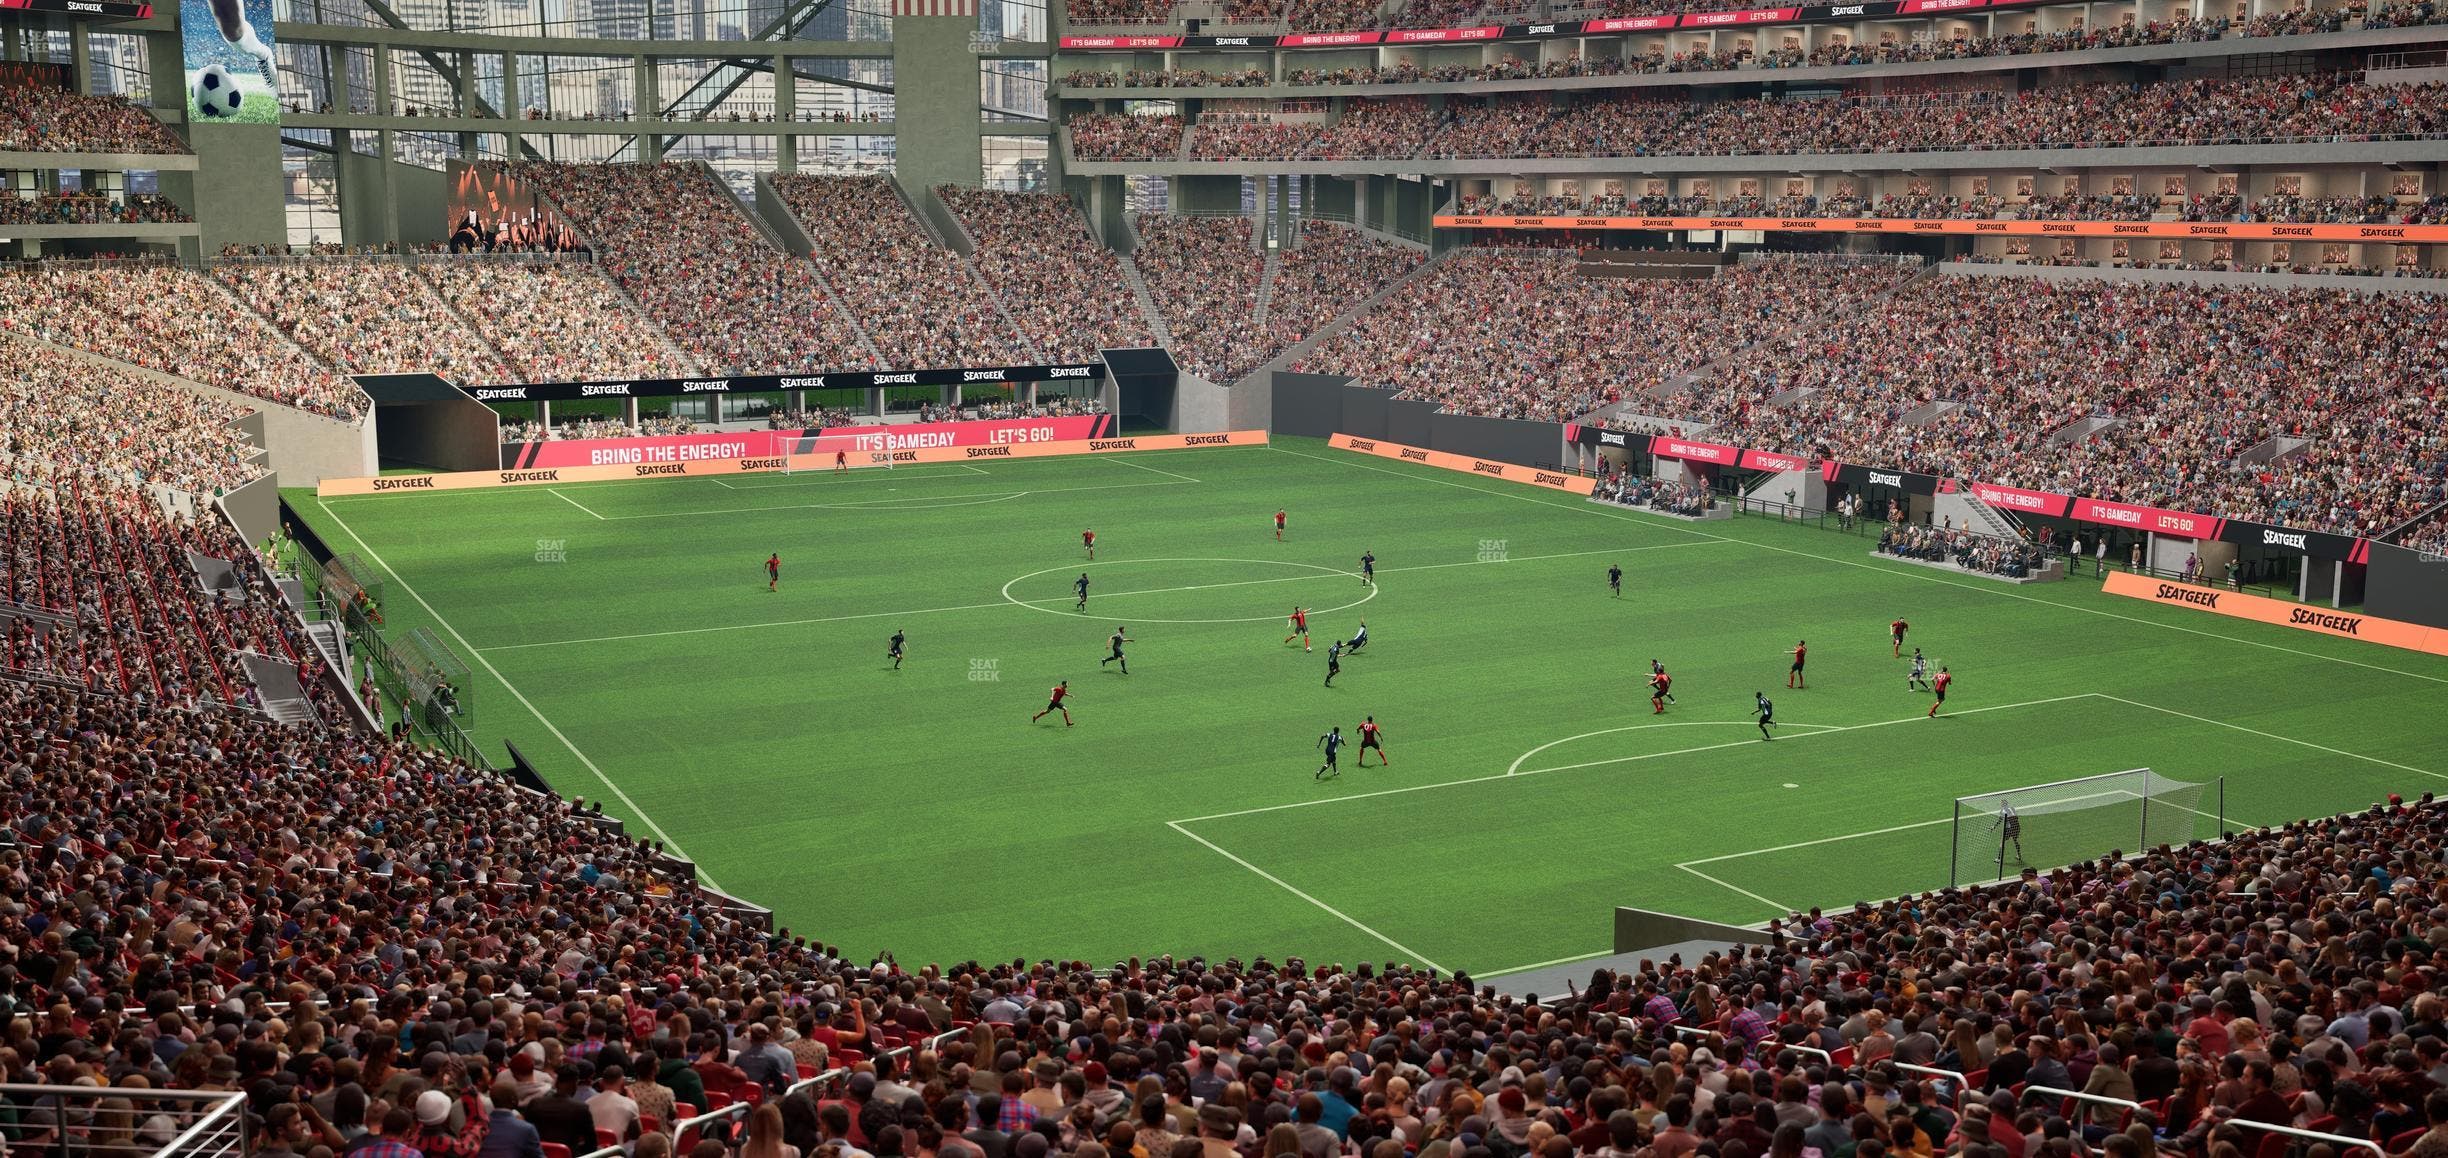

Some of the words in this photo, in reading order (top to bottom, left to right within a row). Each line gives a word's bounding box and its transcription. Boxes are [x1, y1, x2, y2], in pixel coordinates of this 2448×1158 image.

[68, 1, 103, 13] SEATGEEK
[1831, 4, 1864, 16] SEATGEEK
[1605, 20, 1623, 30] BRING
[1623, 20, 1634, 29] THE
[1634, 18, 1658, 28] ENERGY!
[1697, 15, 1709, 24] IT'S
[1709, 14, 1737, 23] GAMEDAY
[1750, 12, 1767, 21] LET'S
[1767, 12, 1779, 20] GO!
[1403, 32, 1415, 40] IT'S
[1416, 31, 1447, 40] GAMEDAY
[1460, 30, 1476, 39] LET'S
[1528, 24, 1555, 35] SEATGEEK
[1129, 39, 1147, 47] LET'S
[1148, 39, 1160, 47] GO!
[1215, 37, 1249, 47] SEATGEEK
[1302, 36, 1322, 45] BRING
[1322, 35, 1333, 44] THE
[1334, 34, 1361, 44] ENERGY!
[1455, 218, 1483, 226] SEATGEEK
[1514, 218, 1544, 226] SEATGEEK
[1576, 218, 1607, 227] SEATGEEK
[1641, 218, 1674, 228] SEATGEEK
[1710, 220, 1744, 228] SEATGEEK
[1782, 220, 1817, 229] SEATGEEK
[1855, 221, 1883, 230] SEATGEEK
[1913, 222, 1943, 231] SEATGEEK
[1976, 222, 2008, 232] SEATGEEK
[2042, 223, 2076, 233] SEATGEEK
[2113, 224, 2149, 234] SEATGEEK
[2190, 225, 2228, 236] SEATGEEK
[2272, 226, 2313, 237] SEATGEEK
[2360, 227, 2405, 239] SEATGEEK
[963, 370, 1006, 382] SEATGEEK
[1050, 366, 1091, 379] SEATGEEK
[779, 376, 826, 389] SEATGEEK
[873, 373, 918, 386] SEATGEEK
[581, 384, 631, 397] SEATGEEK
[682, 380, 731, 393] SEATGEEK
[476, 388, 527, 401] SEATGEEK
[856, 435, 884, 451] IT'S
[887, 431, 956, 450] GAMEDAY
[989, 428, 1028, 445] LET'S
[1030, 427, 1055, 442] GO!
[1185, 434, 1230, 447] SEATGEEK
[1600, 432, 1626, 446] SEATGEEK
[1089, 439, 1136, 451] SEATGEEK
[1349, 438, 1376, 453] SEATGEEK
[1670, 443, 1687, 454] BRING
[1688, 445, 1697, 456] THE
[1698, 446, 1720, 459] ENERGY!
[590, 447, 642, 465] BRING
[646, 446, 676, 462] THE
[679, 442, 746, 461] ENERGY!
[966, 446, 1012, 459] SEATGEEK
[1400, 448, 1429, 462] SEATGEEK
[740, 458, 788, 471] SEATGEEK
[1472, 460, 1505, 476] SEATGEEK
[1756, 456, 1768, 467] IT'S
[635, 463, 687, 476] SEATGEEK
[373, 476, 434, 491] SEATGEEK
[500, 470, 559, 484] SEATGEEK
[1534, 472, 1568, 488] SEATGEEK
[1869, 471, 1902, 488] SEATGEEK
[2003, 492, 2015, 505] THE
[2016, 494, 2044, 509] ENERGY!
[2092, 505, 2106, 519] IT'S
[2106, 508, 2142, 524] GAMEDAY
[2158, 515, 2179, 530] LET'S
[2180, 520, 2194, 532] GO!
[2263, 528, 2307, 550] SEATGEEK
[2156, 584, 2220, 609] SEATGEEK
[2290, 608, 2362, 635] SEATGEEK
